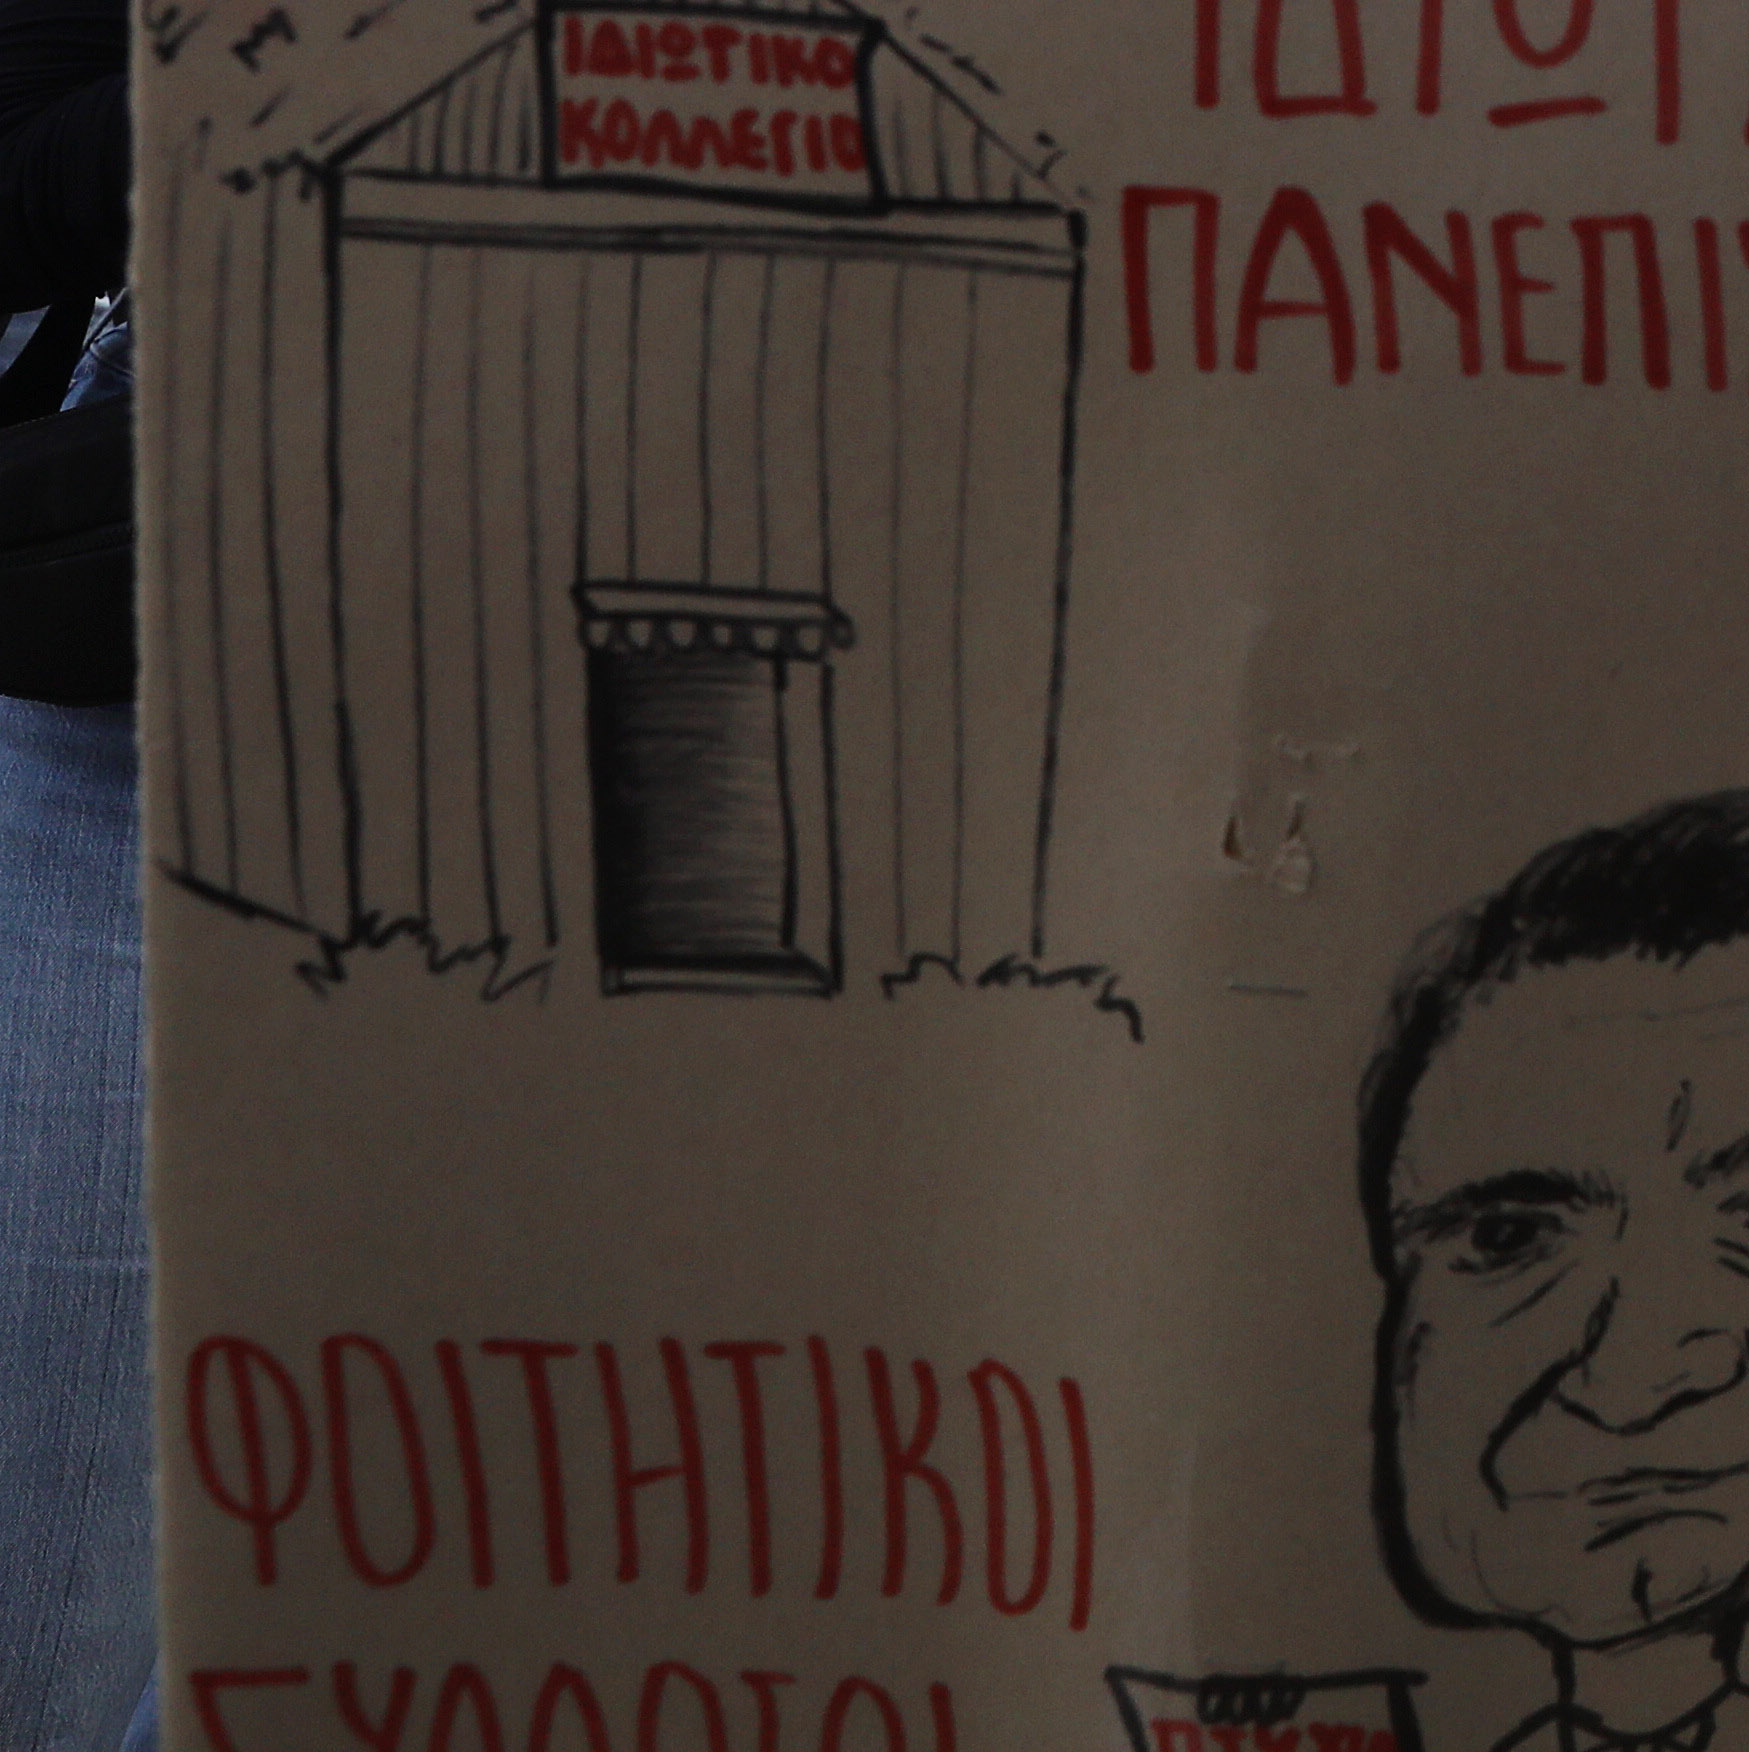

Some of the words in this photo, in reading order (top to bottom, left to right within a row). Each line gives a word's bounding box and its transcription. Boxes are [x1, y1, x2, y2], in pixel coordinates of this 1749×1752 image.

[563, 16, 858, 90] ΙΔΙΩΤΙΚΟ
[560, 96, 868, 177] ΚΟΛΛΕΓΙΟ
[185, 1333, 1096, 1632] ΦΟΙΤΗΤΙΚΟΙ
